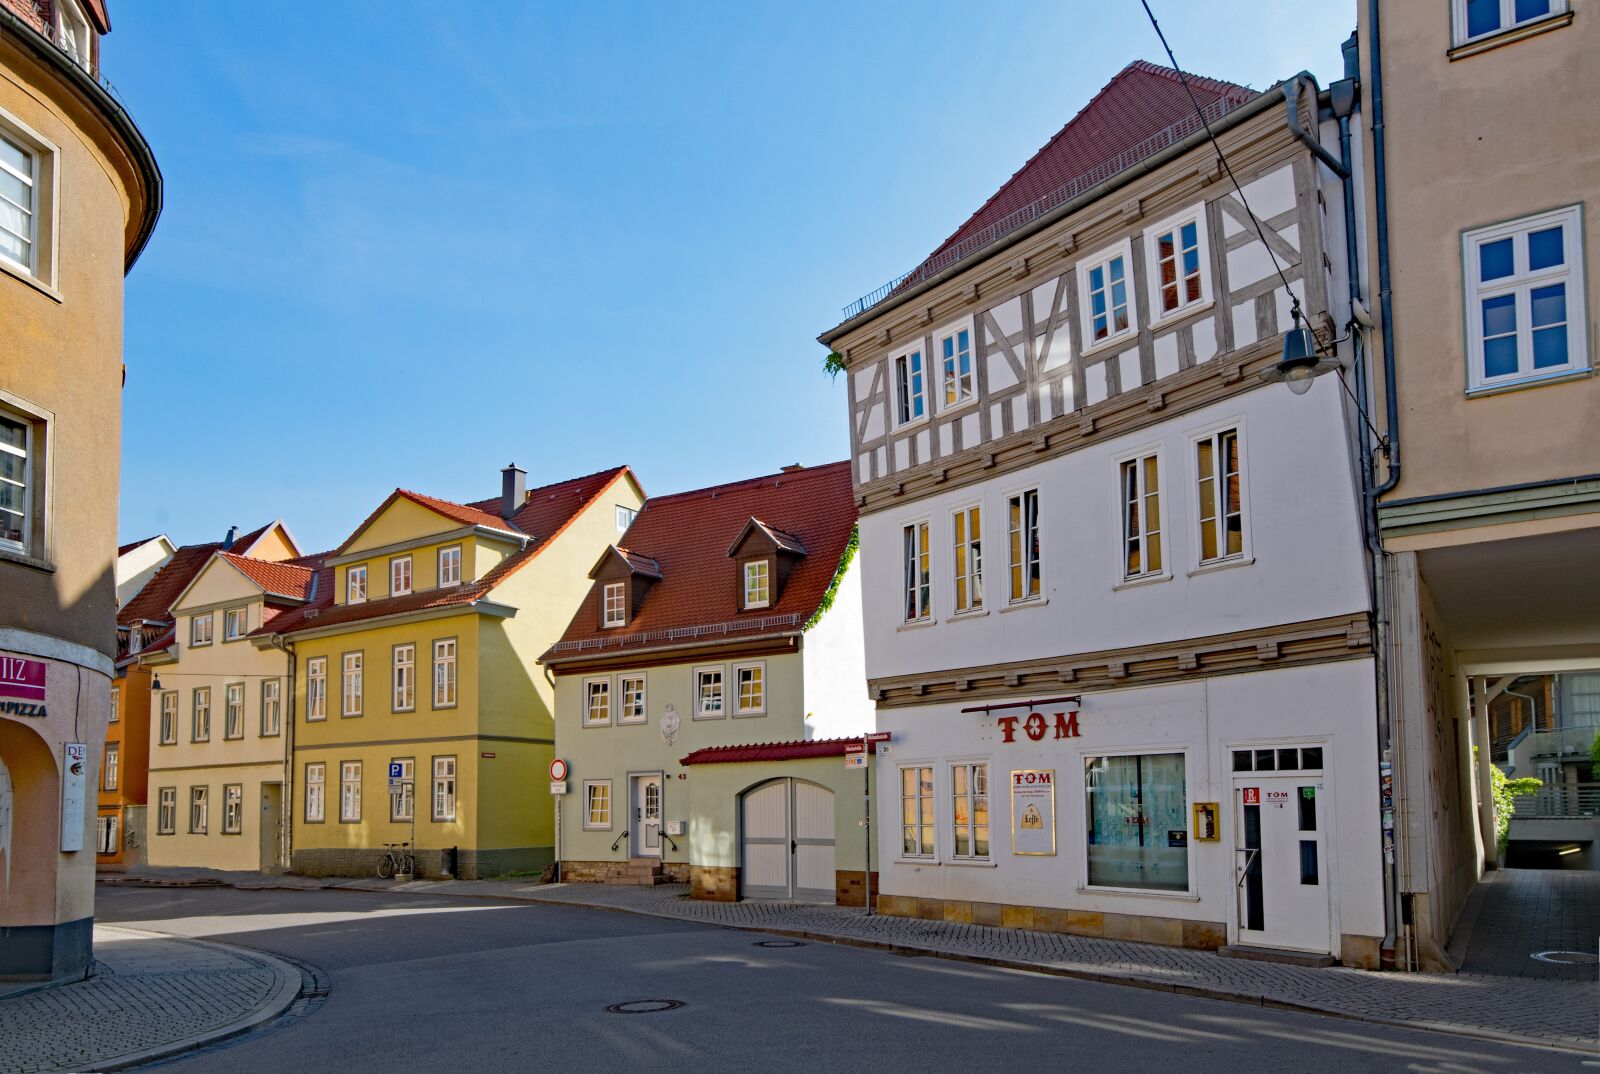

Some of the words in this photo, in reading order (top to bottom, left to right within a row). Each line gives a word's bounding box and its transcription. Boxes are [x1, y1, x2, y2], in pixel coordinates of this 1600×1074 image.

[997, 710, 1082, 743] TOM
[391, 764, 400, 776] P
[1013, 772, 1052, 785] TOM
